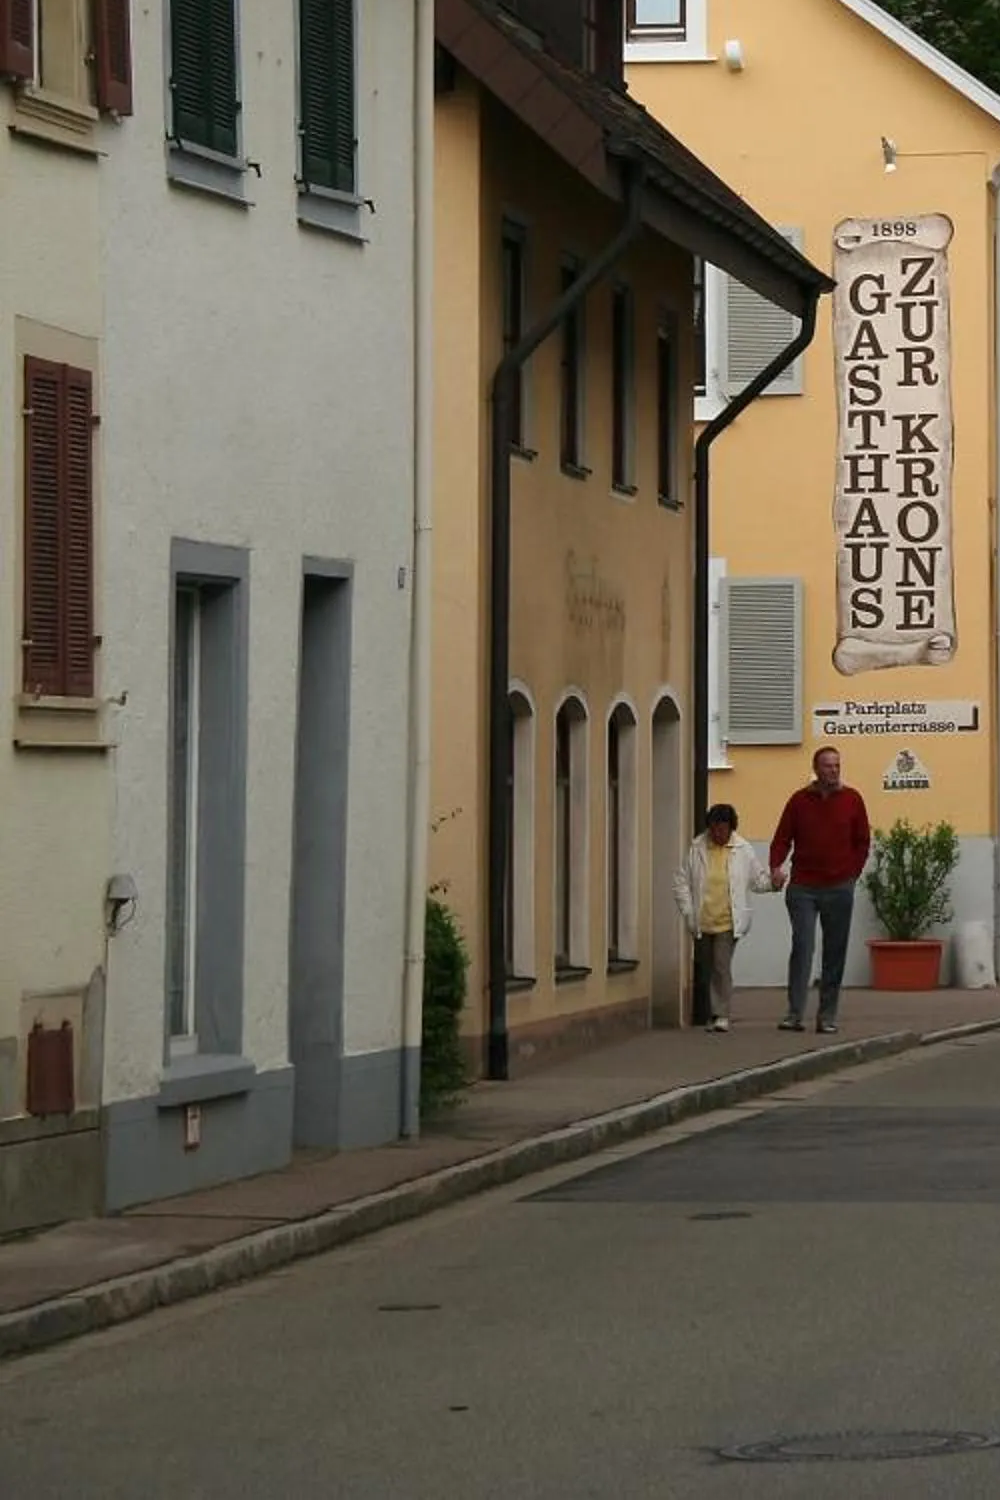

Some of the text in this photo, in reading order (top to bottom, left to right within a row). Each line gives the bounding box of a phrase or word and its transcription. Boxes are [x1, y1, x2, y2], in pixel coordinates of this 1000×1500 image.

[871, 221, 917, 237] 1898
[844, 273, 892, 630] GASTHAUS
[892, 257, 942, 631] ZUR KRONE
[844, 701, 927, 718] Parkplatz
[823, 720, 956, 735] Gartenterrasse
